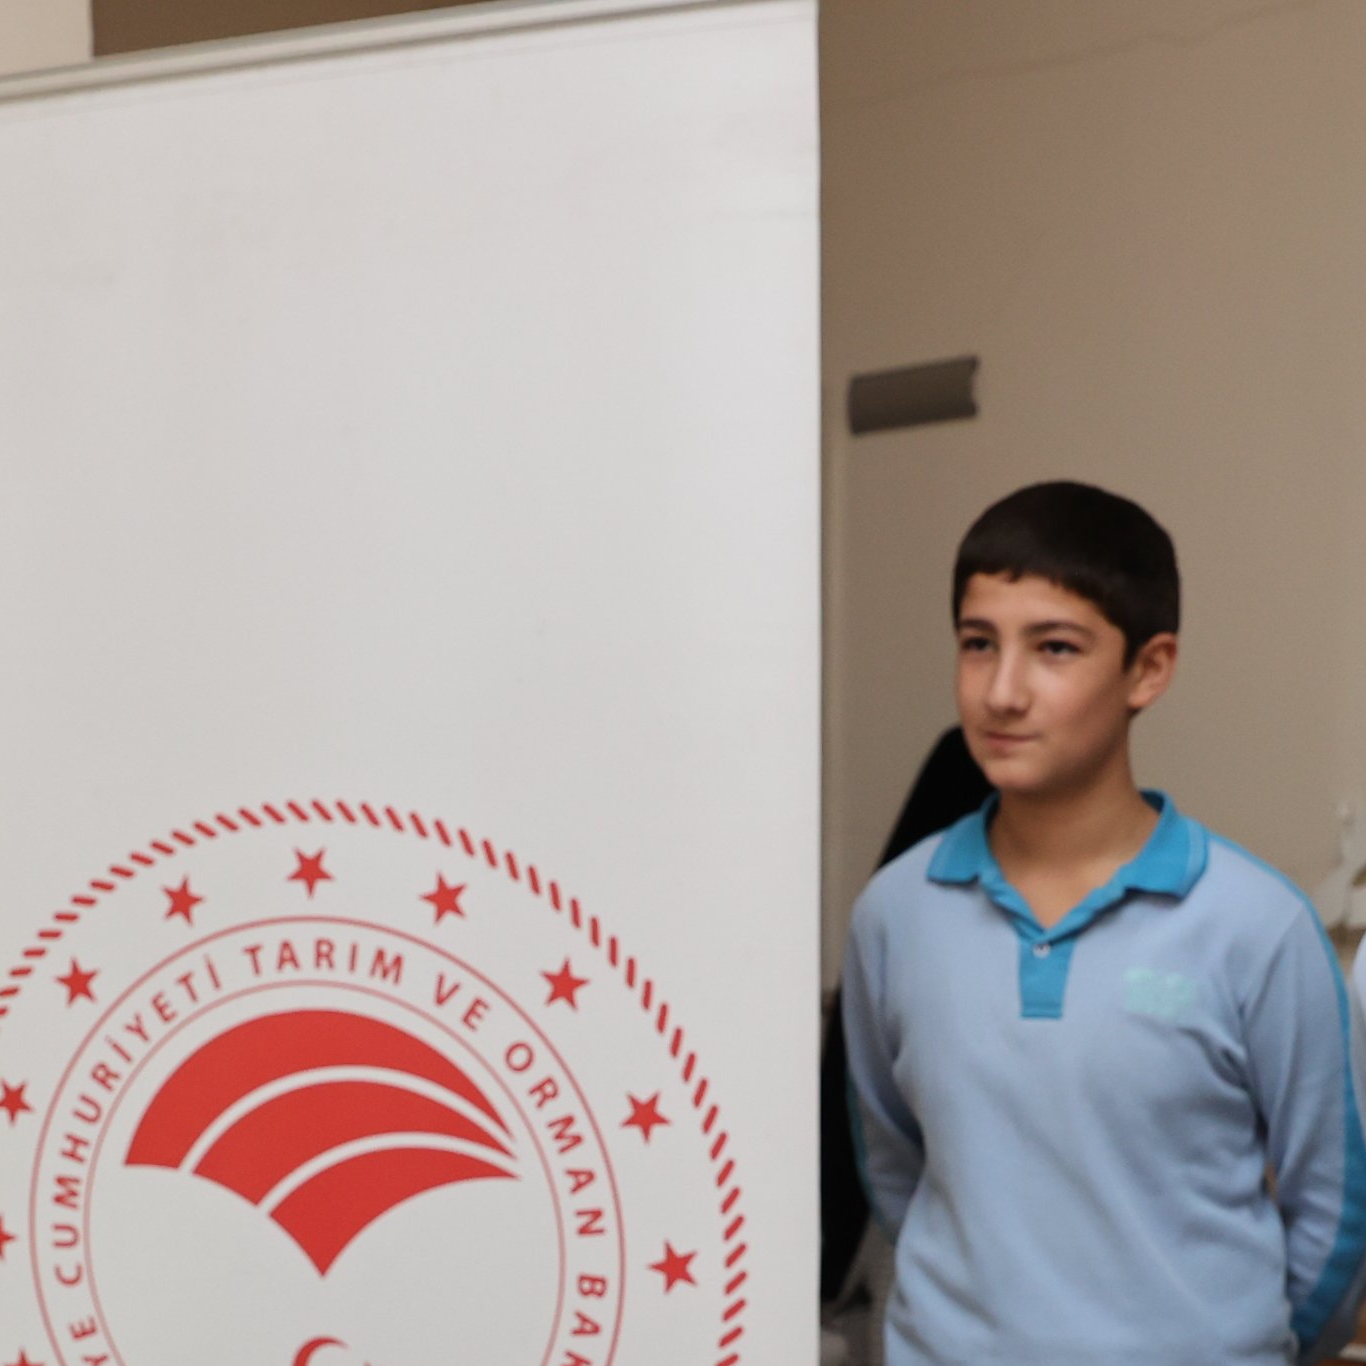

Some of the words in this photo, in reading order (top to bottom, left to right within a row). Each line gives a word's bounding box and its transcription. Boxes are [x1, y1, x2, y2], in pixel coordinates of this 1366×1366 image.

[53, 953, 223, 1287] CUMHURİYETİ
[244, 939, 405, 985] TARIM
[435, 972, 490, 1032] VE
[504, 1042, 605, 1238] ORMAN
